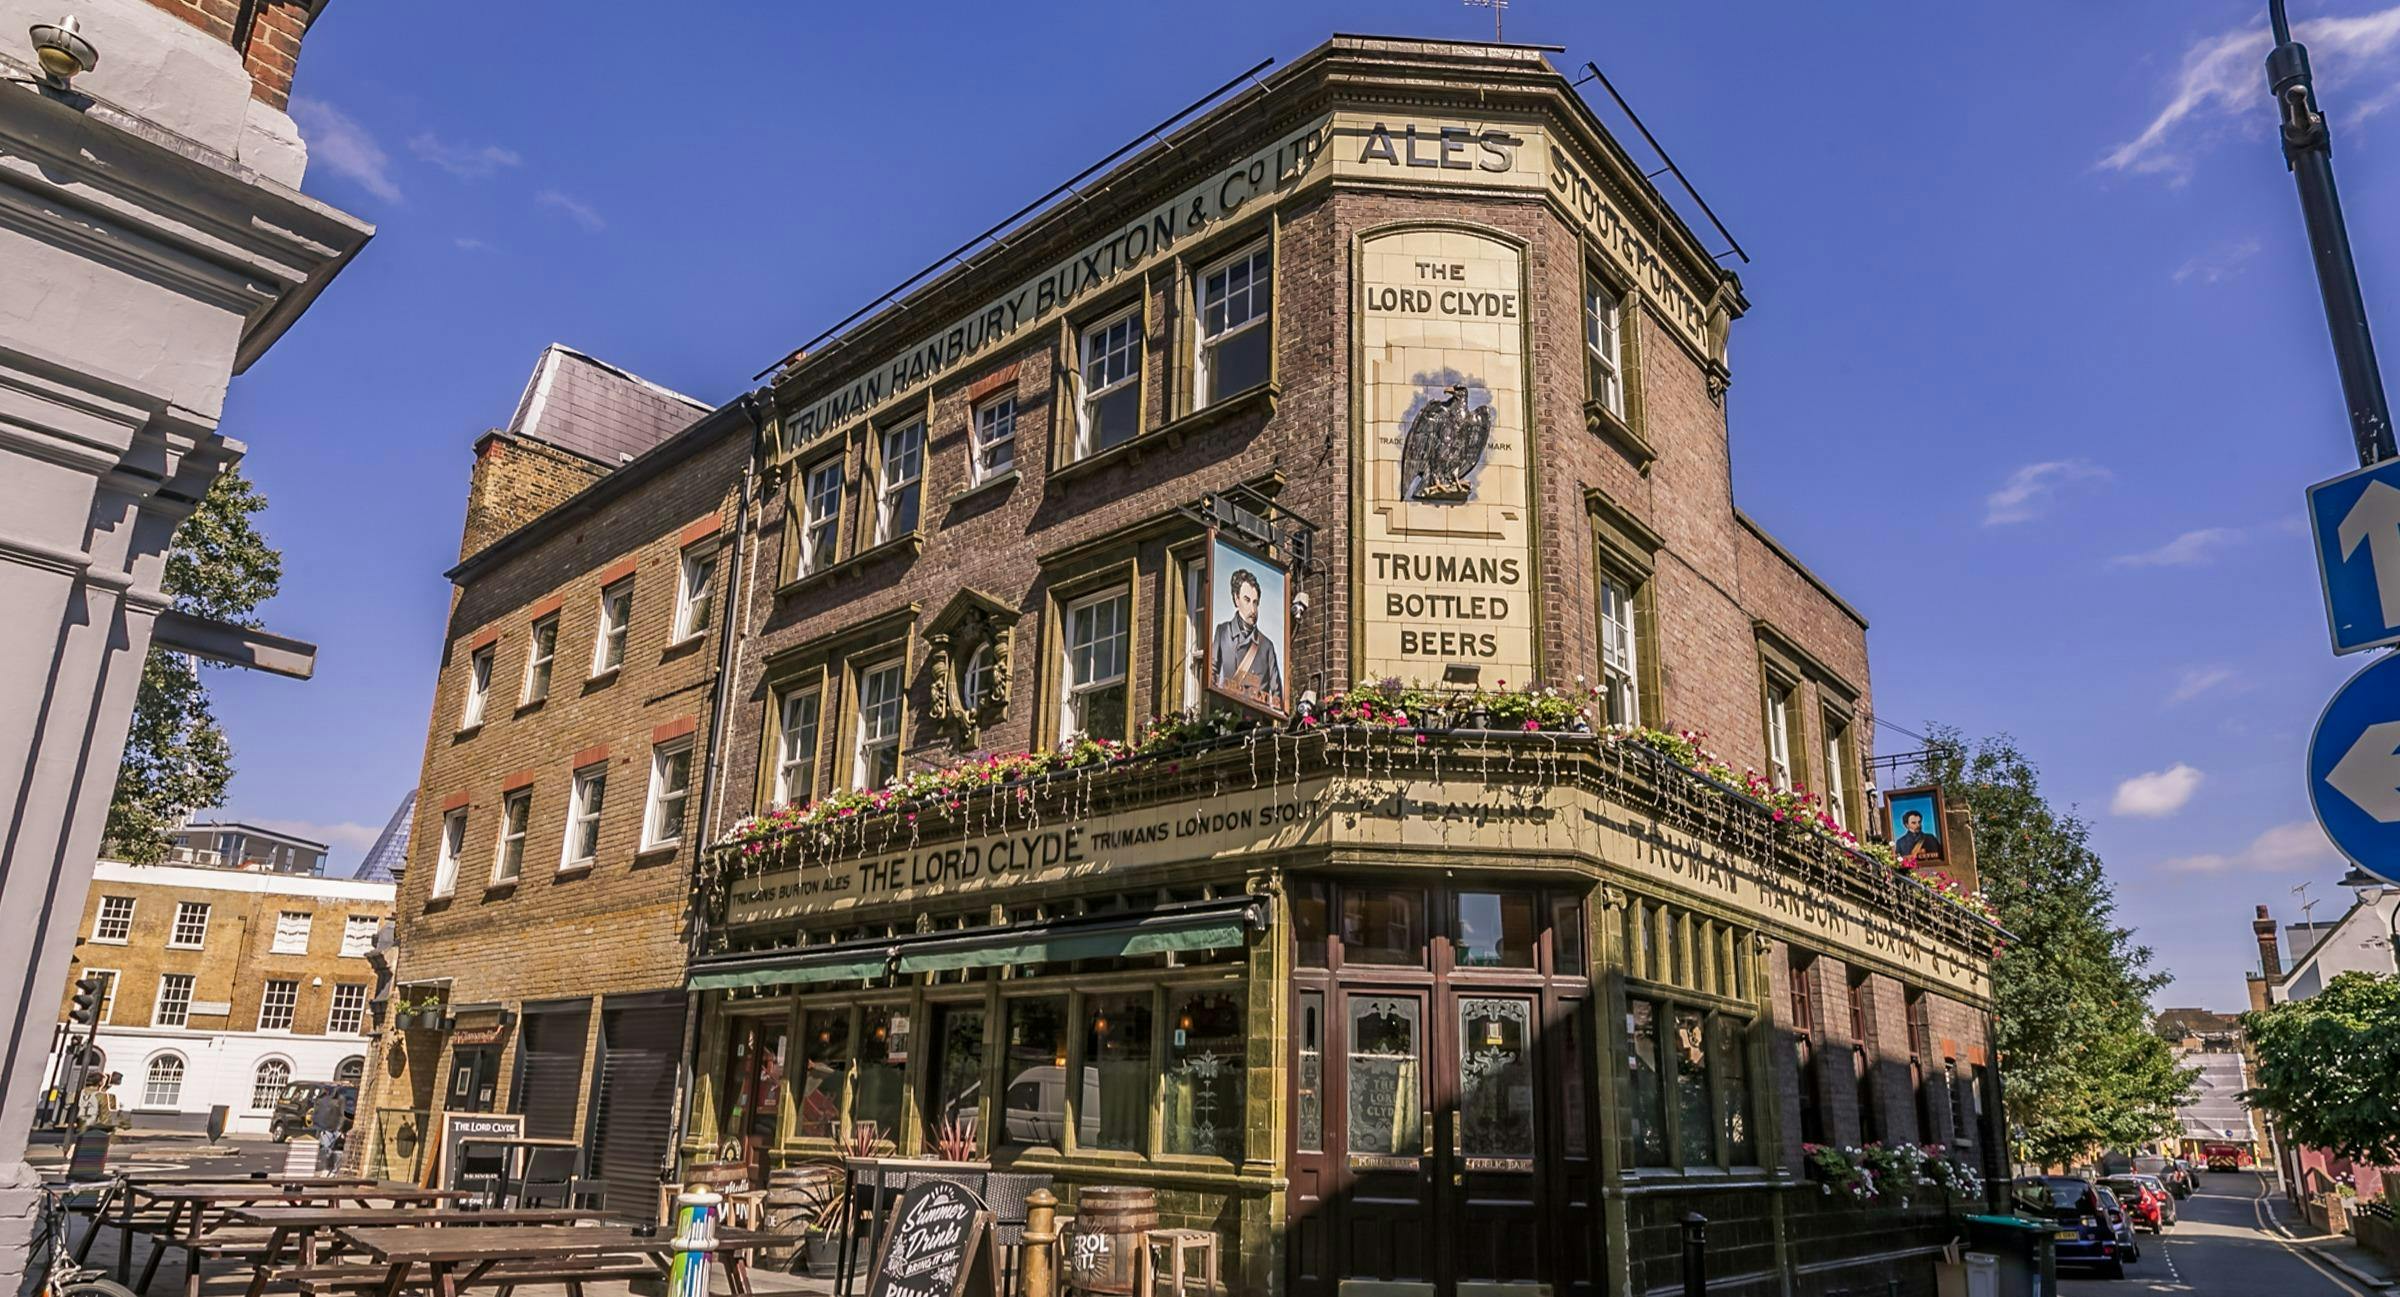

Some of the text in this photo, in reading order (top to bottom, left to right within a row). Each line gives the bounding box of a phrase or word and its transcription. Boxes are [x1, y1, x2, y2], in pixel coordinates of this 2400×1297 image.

[1358, 122, 1514, 173] ALES
[1551, 145, 1620, 250] STOUT
[1635, 234, 1709, 349] PORTER
[1415, 262, 1465, 281] THE
[1368, 286, 1518, 318] LORD CLYDE
[788, 373, 881, 447] TRUMAN
[891, 290, 1027, 398] HANBURY
[1035, 206, 1176, 316] BUXTON
[1187, 196, 1207, 229] &
[1488, 442, 1512, 451] MARK
[1371, 552, 1521, 585] TRUMANS
[1387, 593, 1509, 621] BOTTLED
[1401, 630, 1498, 658] BEERS
[1090, 800, 1324, 851] TRUMANS LONDON STOUT
[858, 826, 1084, 894] THE LORD CLYDE
[732, 875, 850, 906] TRUMANS BURTON ALES
[1628, 818, 1738, 894] TRUMAN
[1757, 874, 1850, 937] HANBURY
[1865, 916, 1922, 964] BUXTON
[1373, 1079, 1396, 1090] THE
[454, 1121, 516, 1133] THE LORD CLYDE
[1366, 1106, 1394, 1117] CLYD
[901, 1193, 969, 1233] Summer
[905, 1221, 962, 1260] Drinks
[905, 1257, 931, 1276] BRING
[932, 1254, 943, 1266] IT
